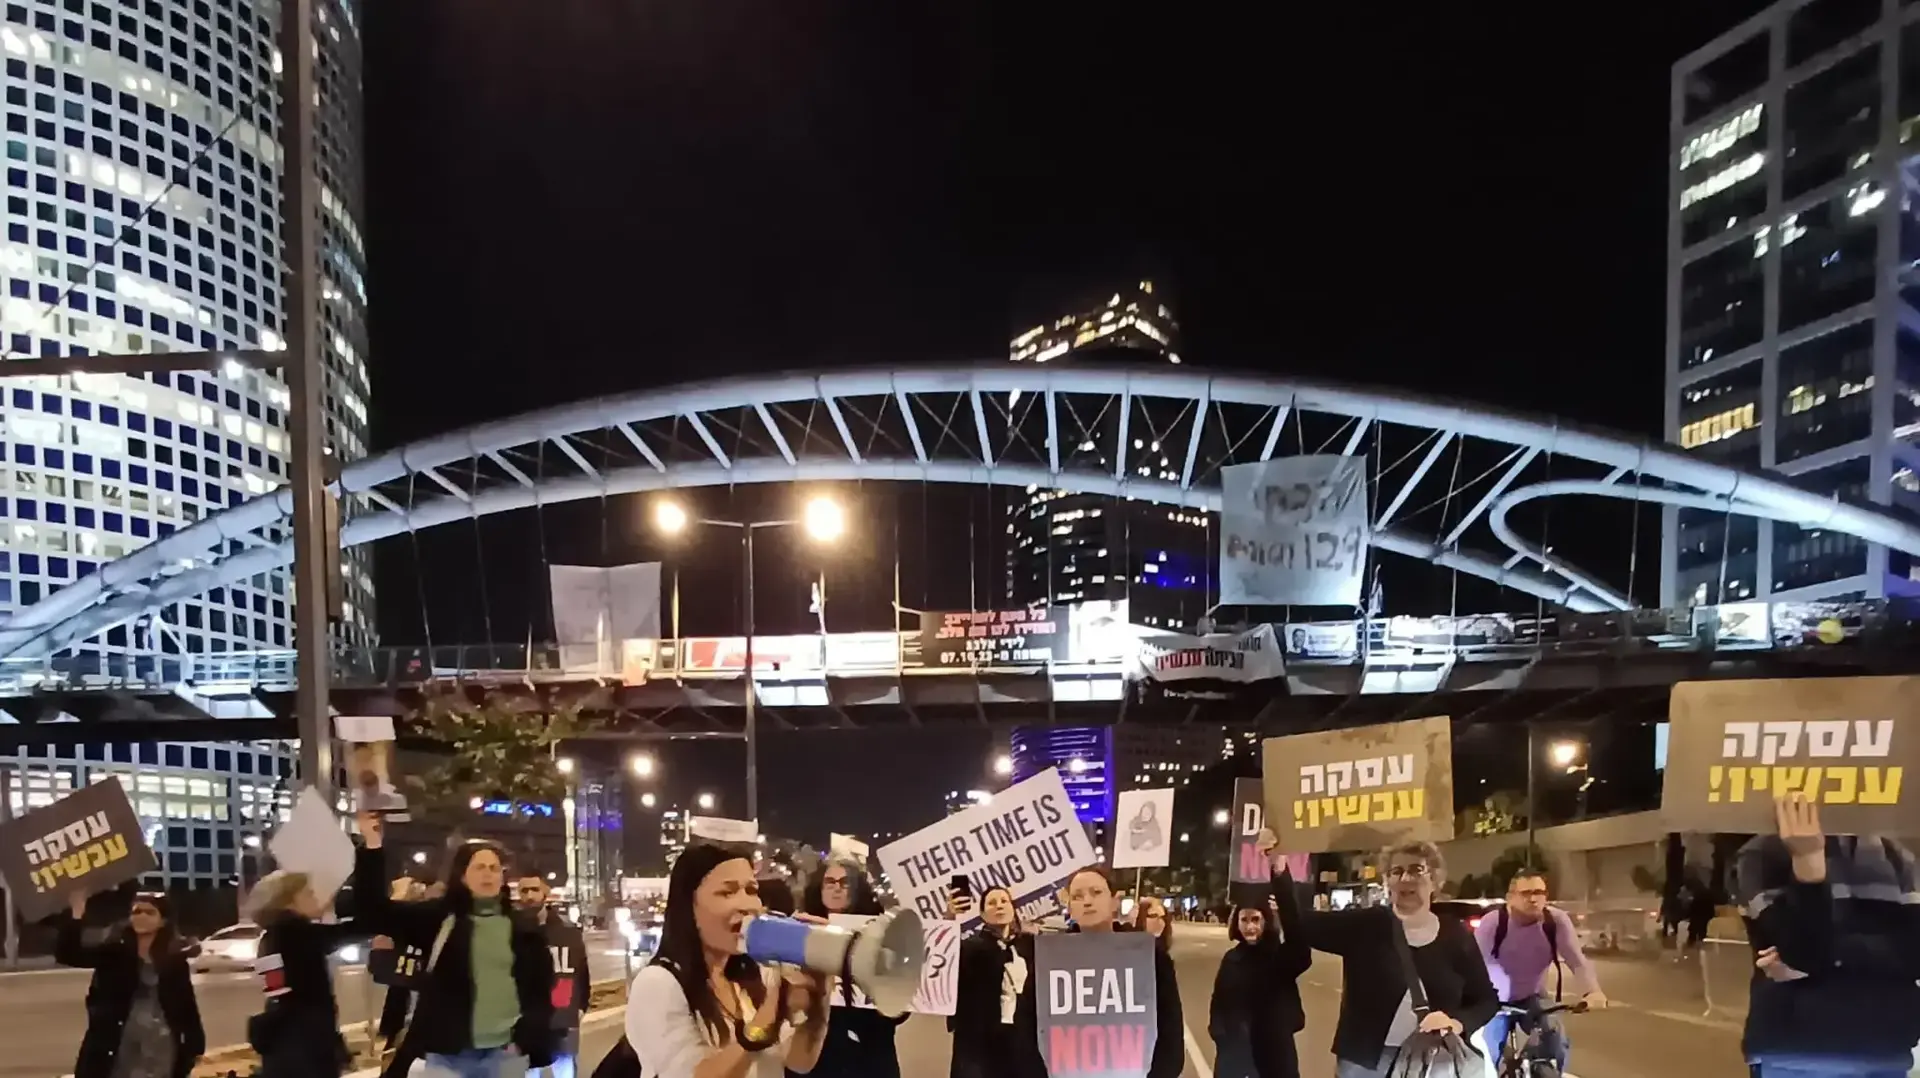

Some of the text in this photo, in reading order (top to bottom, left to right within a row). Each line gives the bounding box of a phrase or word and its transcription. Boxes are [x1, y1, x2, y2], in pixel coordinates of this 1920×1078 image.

[1722, 719, 1894, 765] עסקה
[1300, 754, 1414, 797] עסקה
[1708, 765, 1903, 804] עכשיו!
[1294, 788, 1424, 829] עכשיו!
[23, 810, 111, 865] עסקה
[898, 794, 1062, 888] THEIR TIME IS
[1025, 828, 1075, 874] OUT
[30, 833, 128, 893] עכשיו!
[1049, 967, 1147, 1015] DEAL
[1049, 1023, 1146, 1074] NOW
